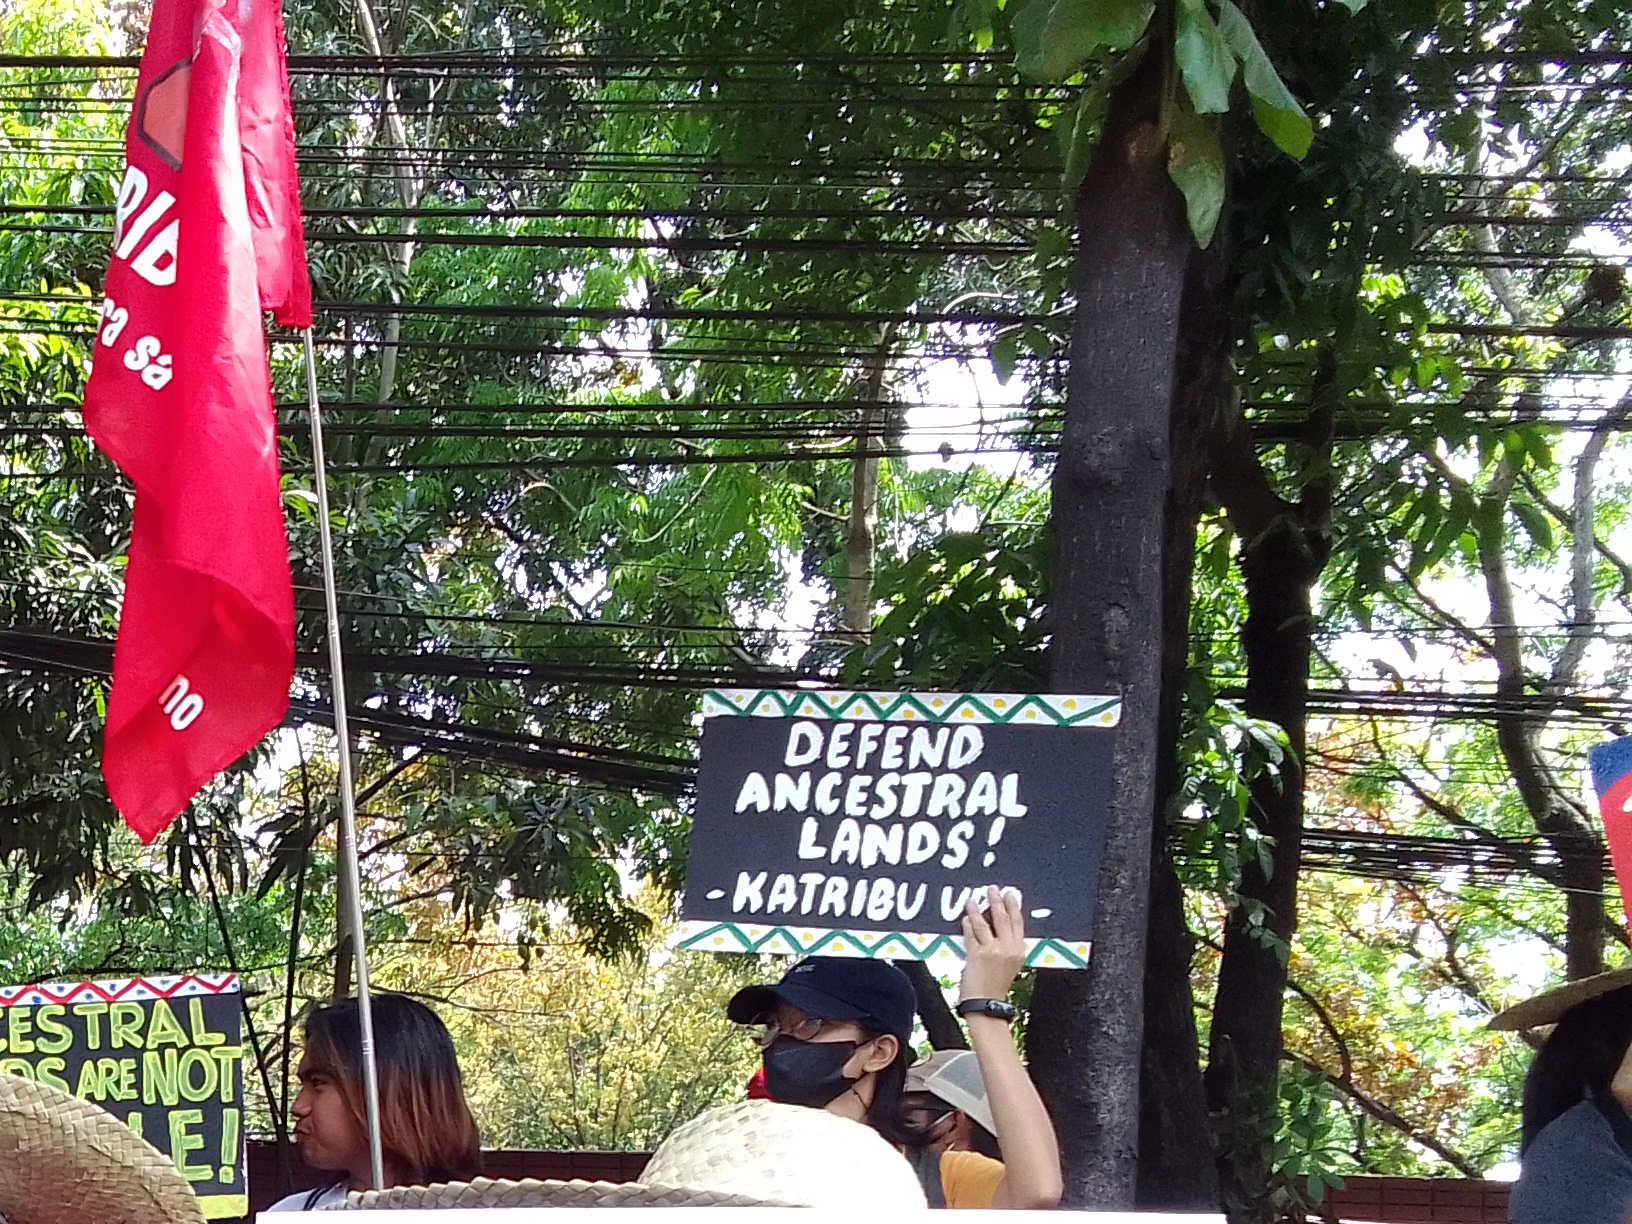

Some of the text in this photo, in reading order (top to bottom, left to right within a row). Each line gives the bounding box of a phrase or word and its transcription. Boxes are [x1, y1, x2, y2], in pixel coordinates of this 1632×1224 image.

[784, 721, 984, 771] DEFEND
[734, 771, 1028, 819] ANCESTRAL
[797, 816, 1006, 870] LANDS!
[732, 871, 926, 920] KATRIBU
[76, 1057, 139, 1102] ARE
[142, 1046, 242, 1106] NOT
